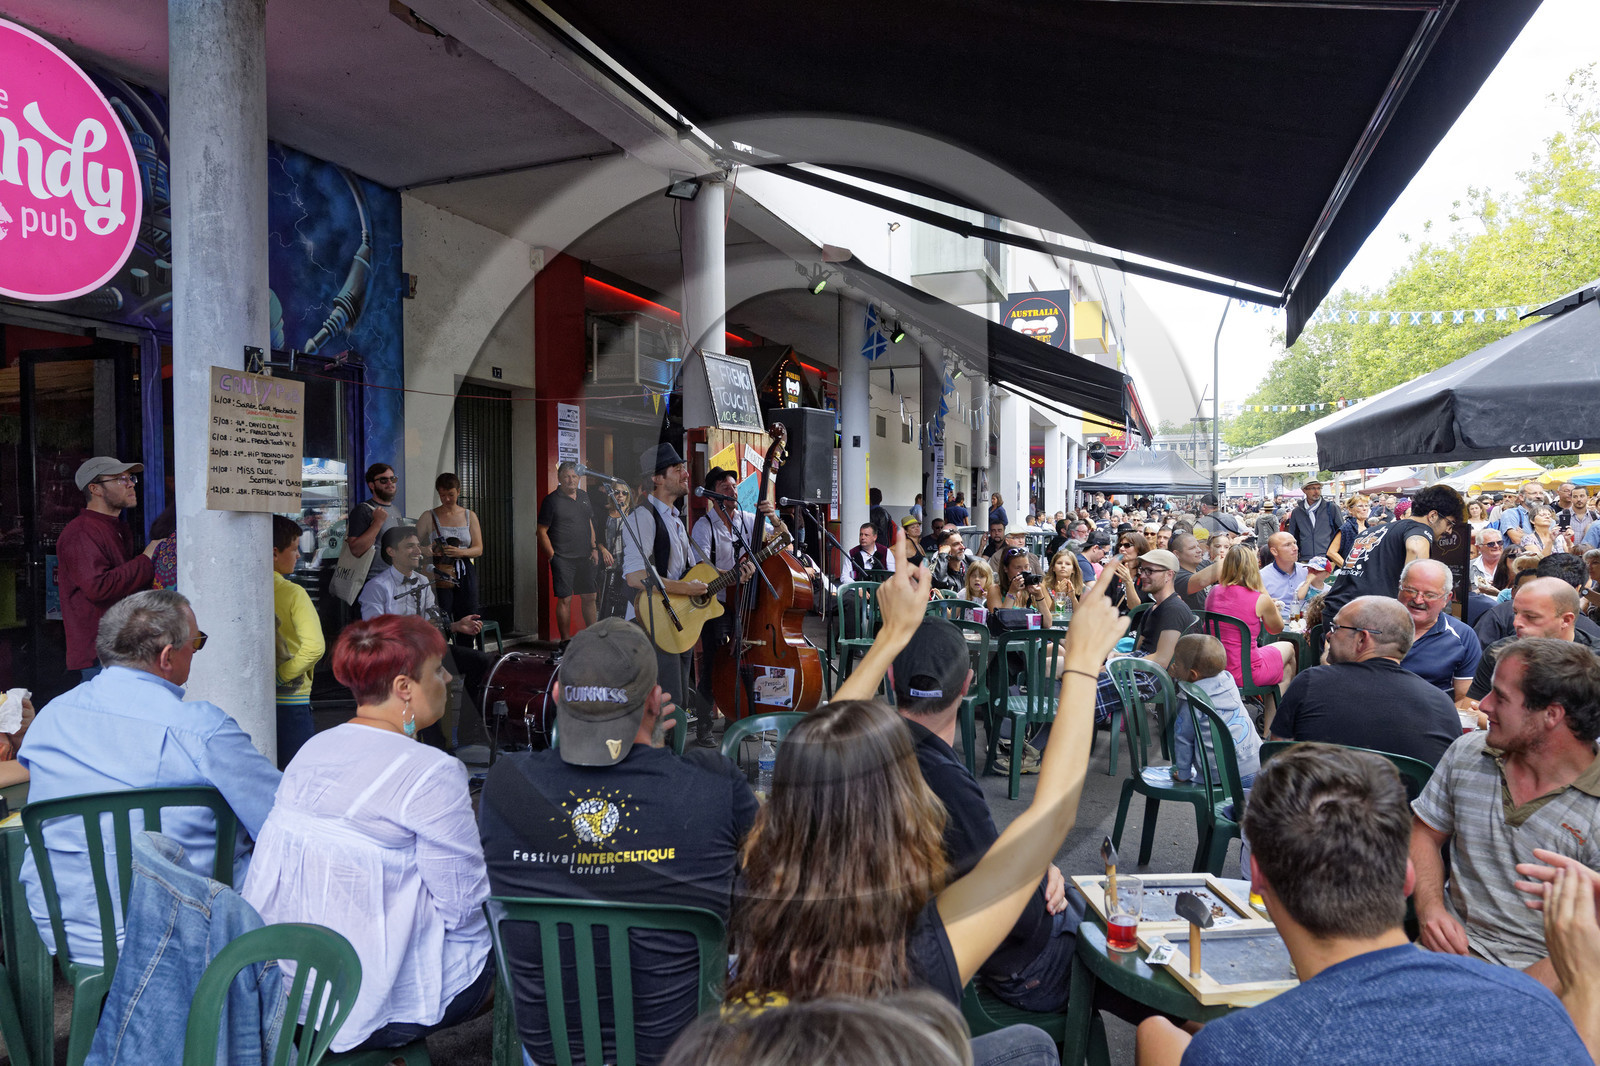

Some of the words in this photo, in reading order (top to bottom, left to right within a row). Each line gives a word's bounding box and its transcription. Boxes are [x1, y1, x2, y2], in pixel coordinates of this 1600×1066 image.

[21, 206, 77, 241] pub
[1010, 308, 1059, 318] AUSTRALIA
[220, 374, 273, 404] CANDY
[715, 387, 750, 412] TOUCH
[248, 421, 267, 429] DAVID
[251, 488, 277, 496] FRENCH
[565, 685, 629, 704] GUINNESS
[513, 850, 575, 864] Festival
[577, 848, 675, 864] INTERCELTIQUE
[569, 864, 616, 874] Lorient
